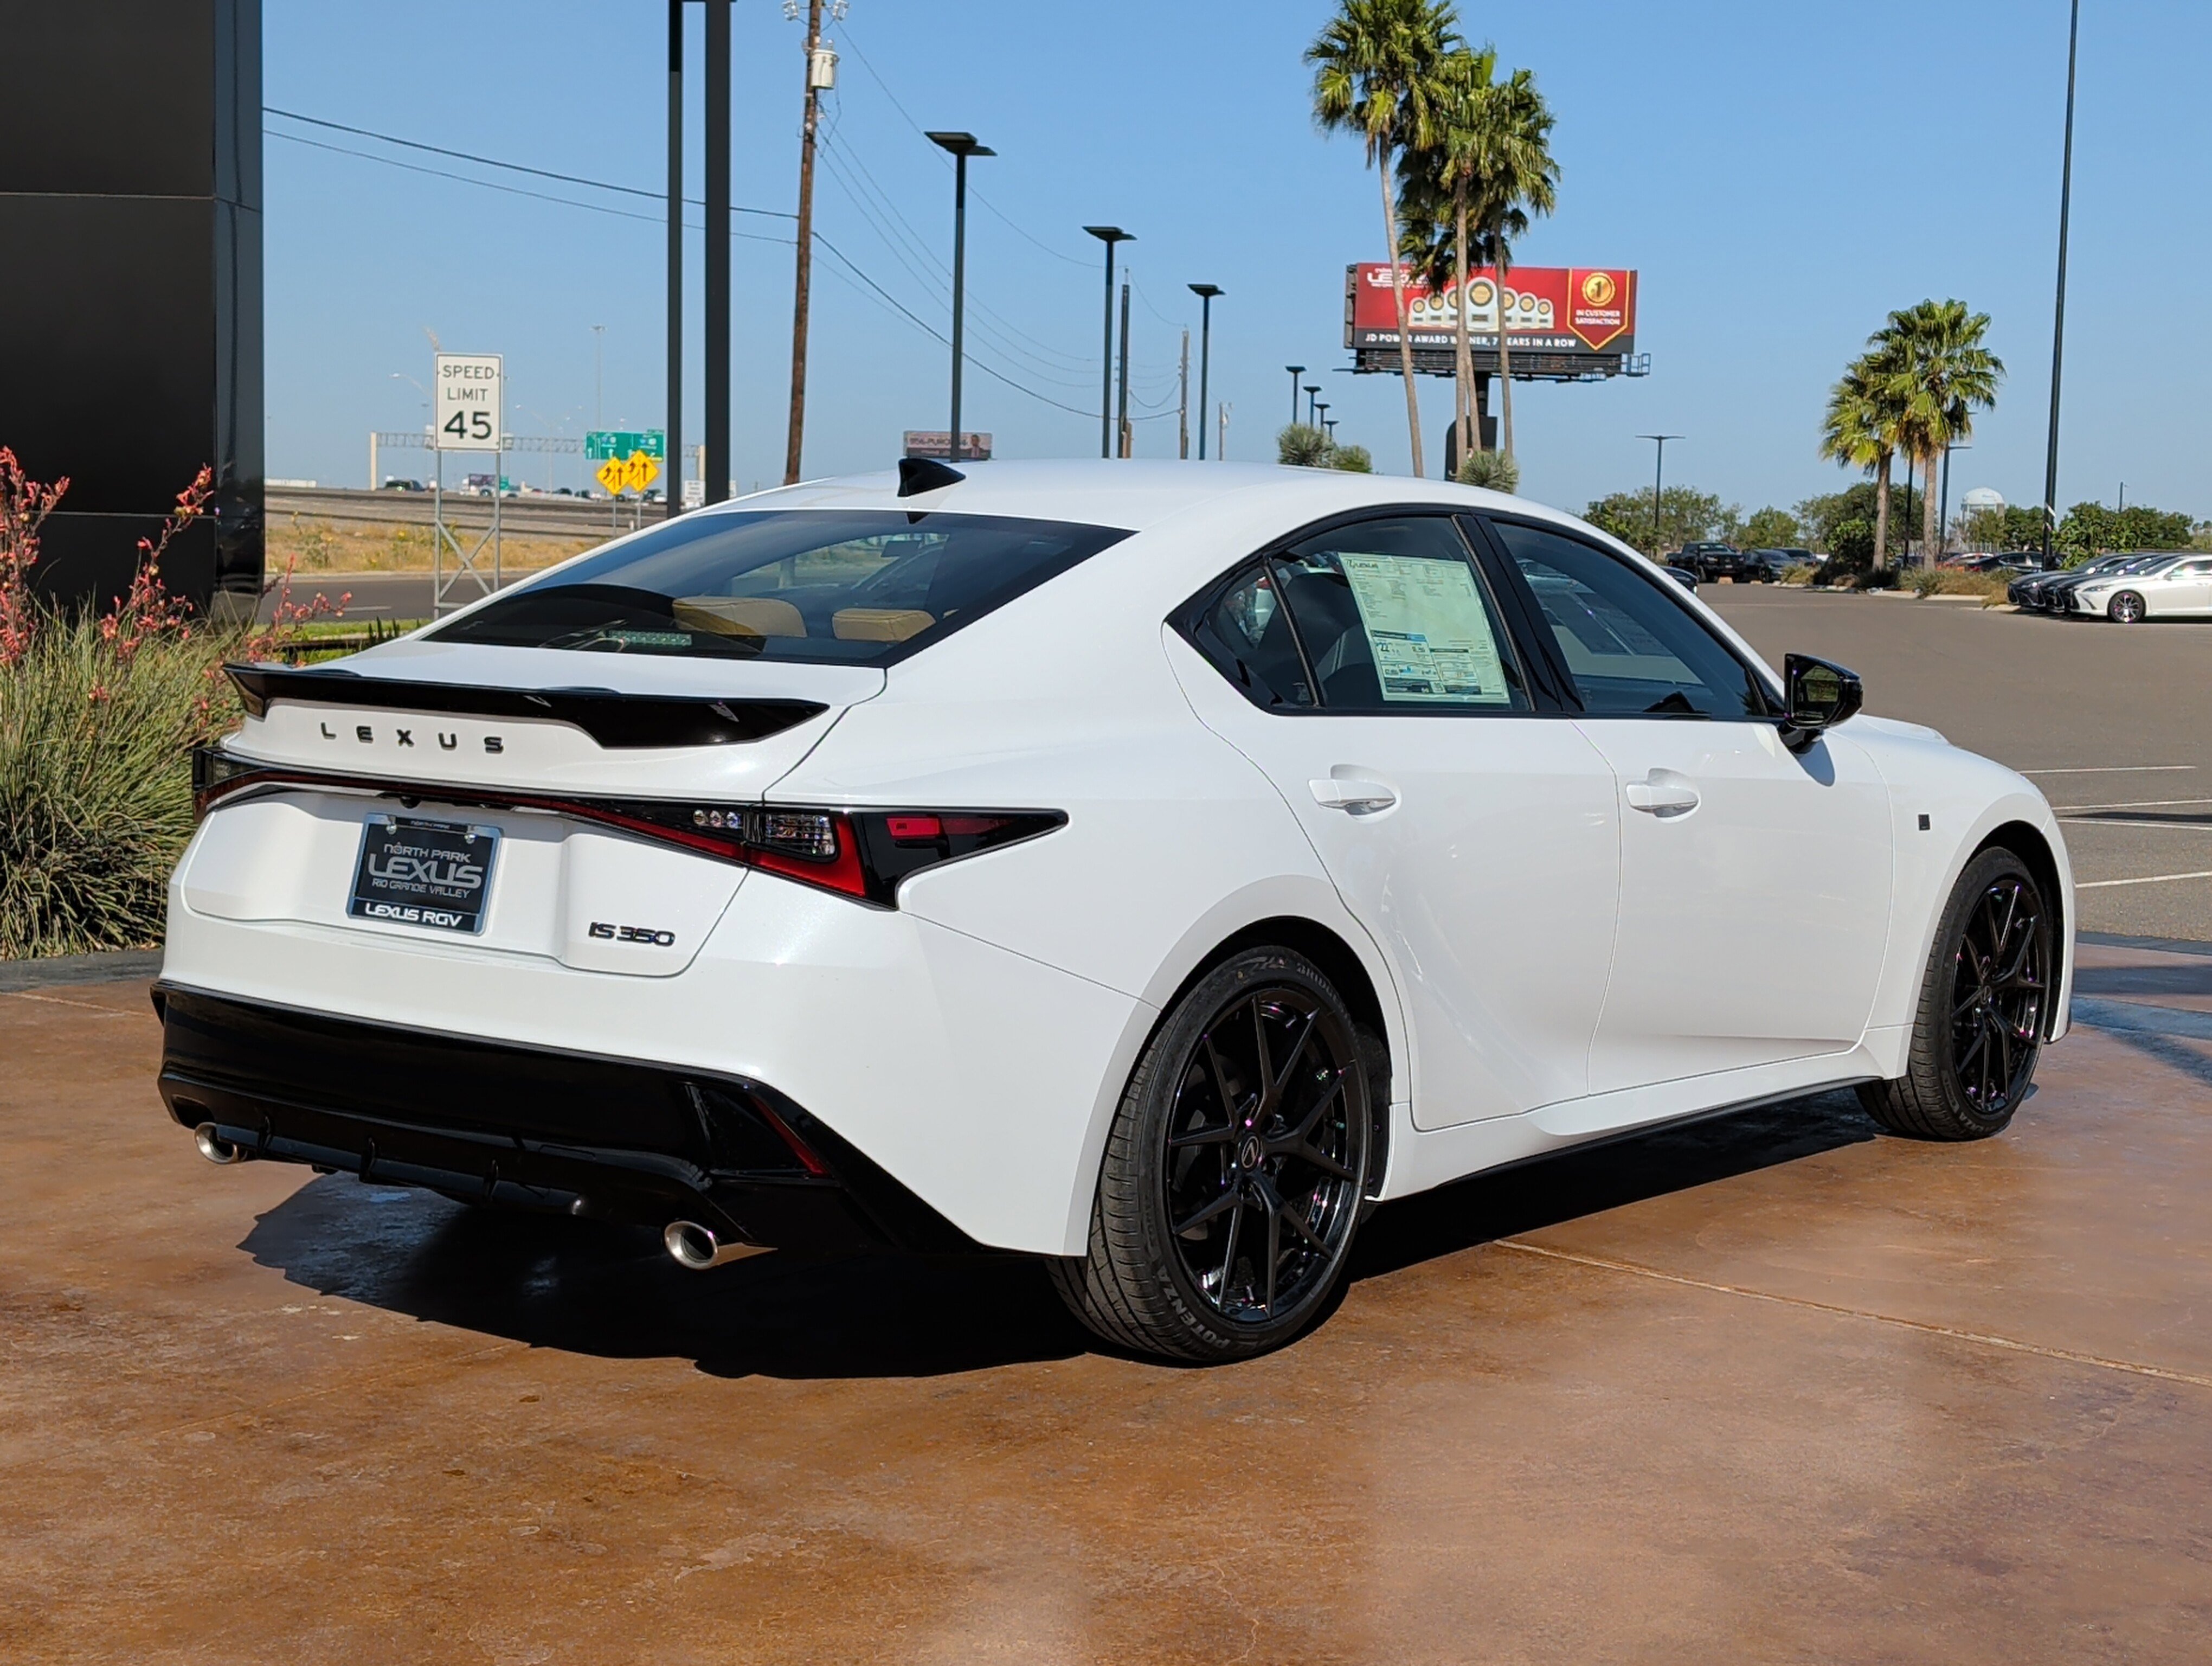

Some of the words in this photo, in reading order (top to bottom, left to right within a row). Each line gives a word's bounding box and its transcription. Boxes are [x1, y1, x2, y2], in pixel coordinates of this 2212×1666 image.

[1379, 334, 1412, 343] POWR
[1414, 334, 1449, 344] AWARD
[1450, 335, 1491, 346] WNER,
[1506, 337, 1531, 347] EARS
[1532, 337, 1543, 347] IN
[1545, 338, 1553, 347] A
[1554, 338, 1577, 348] ROW
[442, 364, 495, 380] SPEED
[447, 387, 488, 401] LIMIT
[443, 410, 492, 440] 45
[320, 722, 504, 754] LEXUS
[384, 842, 429, 858] NORTH
[431, 849, 472, 863] PARK
[368, 853, 484, 889] LEXUS
[372, 877, 388, 888] RIO
[389, 879, 427, 893] GRANDE
[429, 885, 471, 899] VALLEY
[365, 902, 420, 921] LEXUS
[422, 911, 463, 927] RGV
[588, 921, 616, 939] IS
[616, 925, 676, 947] 350
[1157, 1265, 1231, 1349] POTENZA
